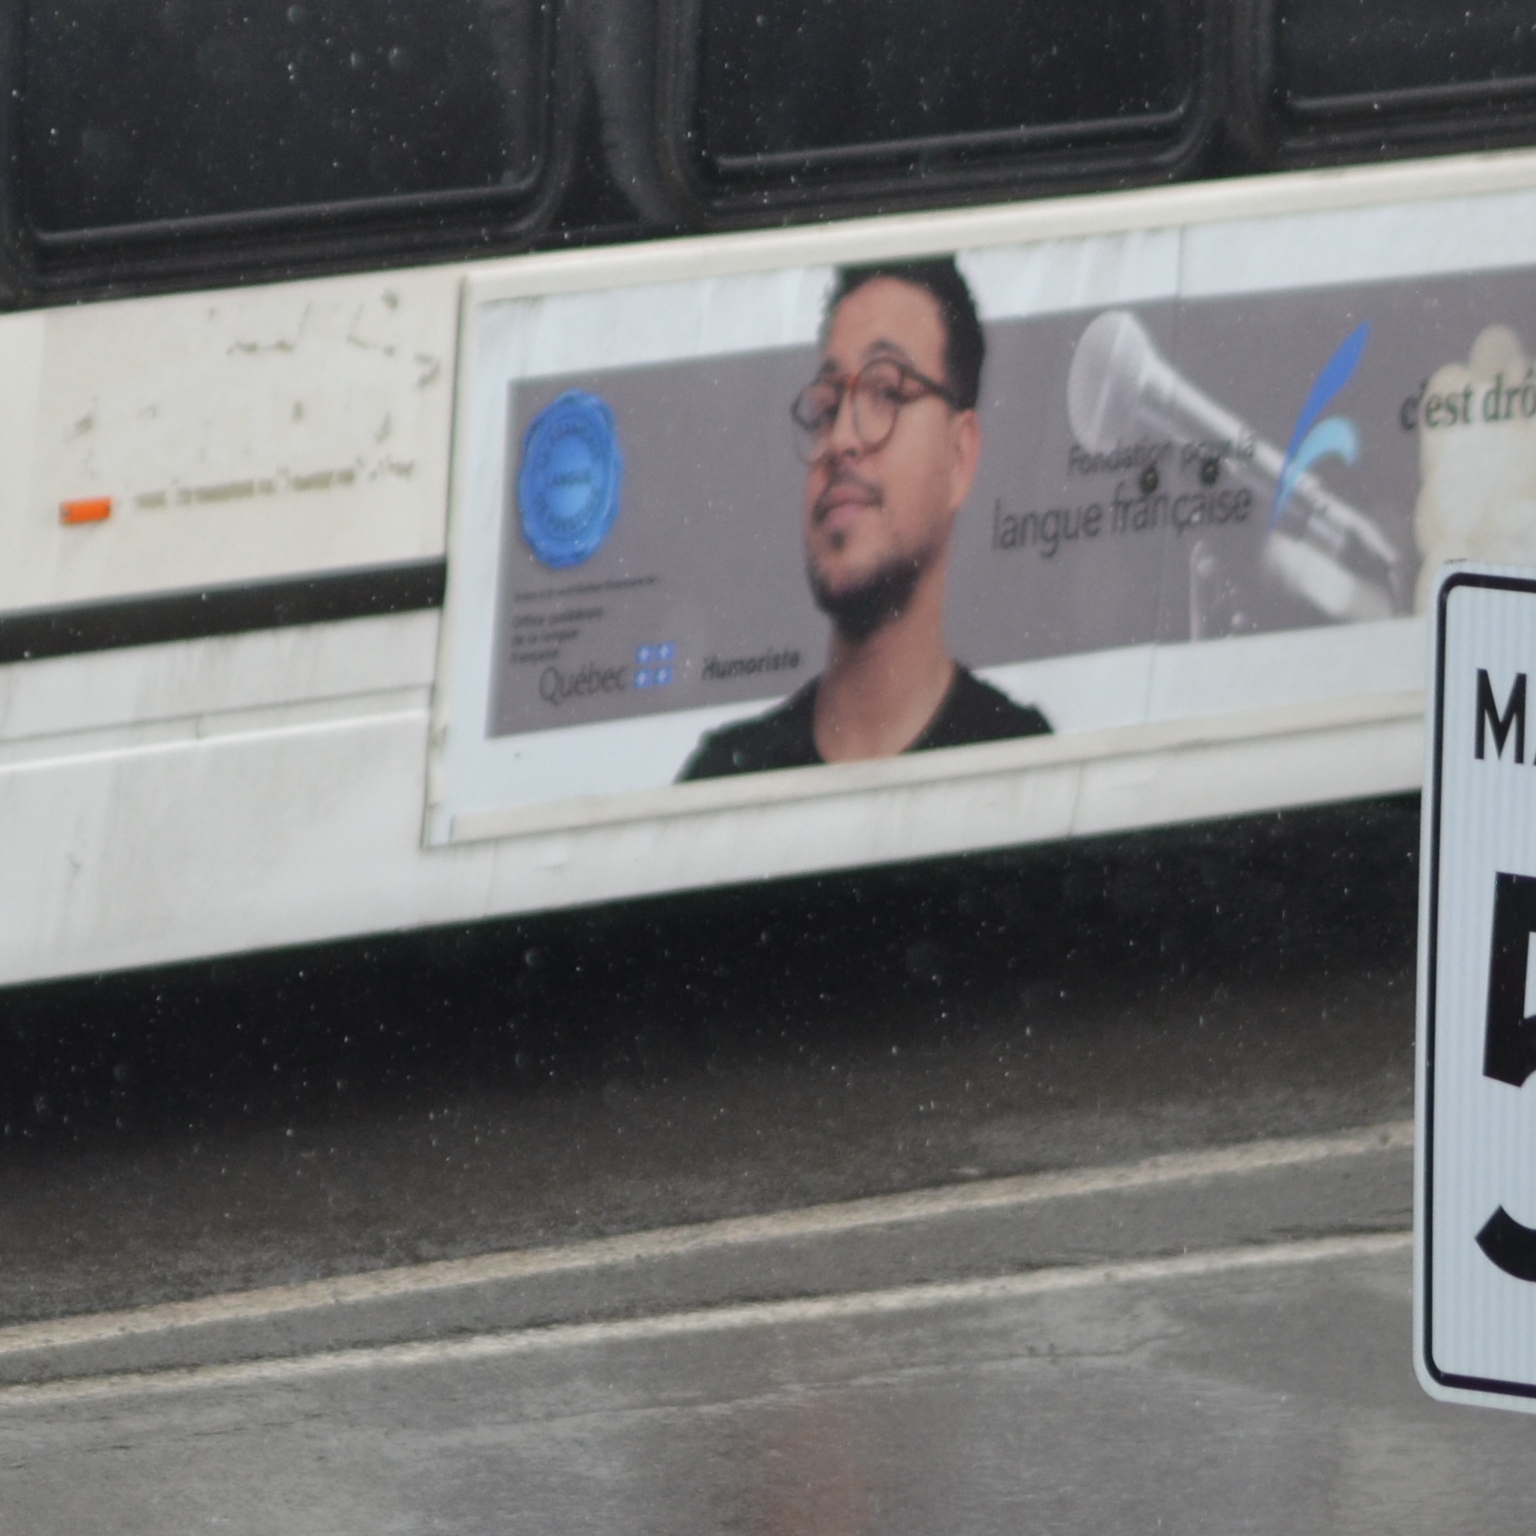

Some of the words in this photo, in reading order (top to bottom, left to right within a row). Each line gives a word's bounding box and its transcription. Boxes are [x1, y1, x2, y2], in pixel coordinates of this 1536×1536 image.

[1400, 379, 1473, 431] c'est
[992, 497, 1103, 559] langue
[1110, 481, 1253, 537] française
[538, 658, 629, 707] Québec
[701, 645, 802, 681] Humoriste
